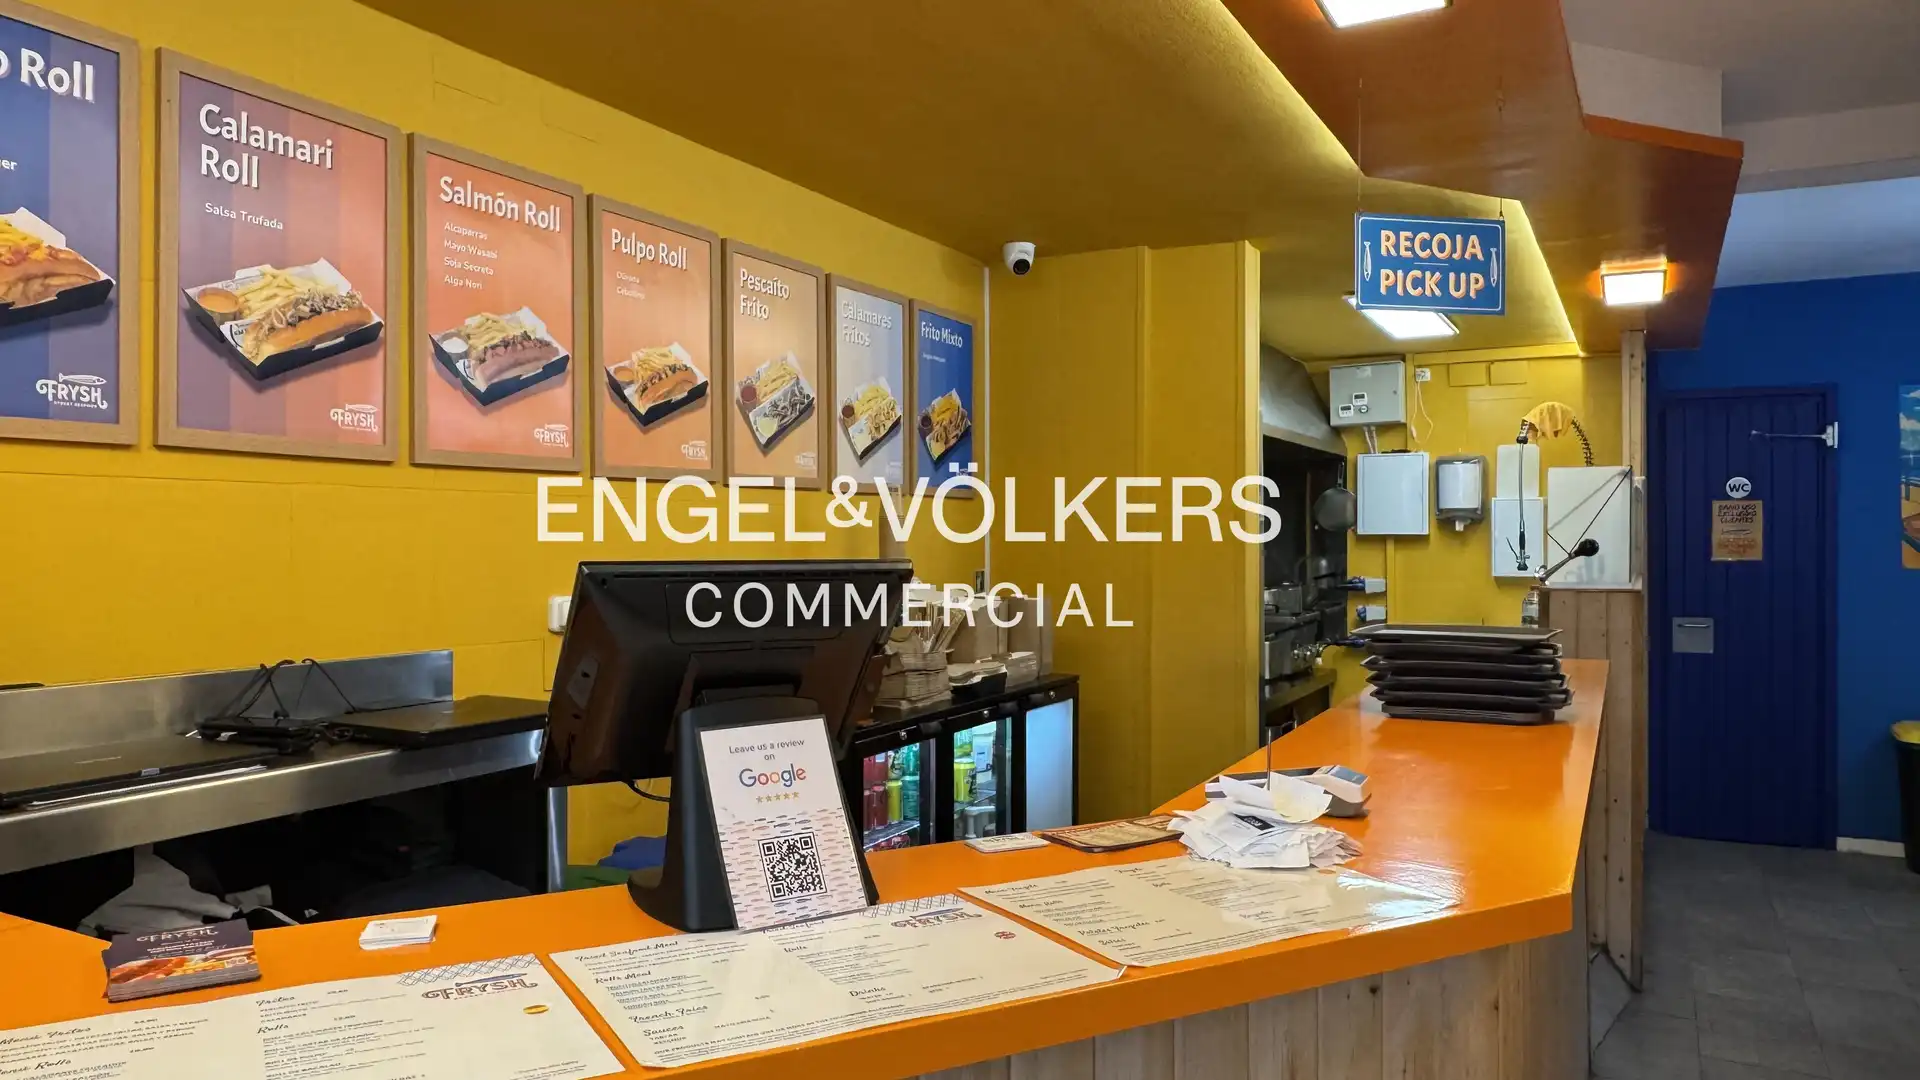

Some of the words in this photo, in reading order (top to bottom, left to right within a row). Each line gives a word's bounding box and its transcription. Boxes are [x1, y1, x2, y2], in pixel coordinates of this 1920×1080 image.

[21, 47, 95, 103] Roll
[199, 103, 333, 170] Calamari
[201, 143, 260, 189] Roll
[204, 202, 233, 219] Salsa
[239, 210, 284, 230] Trufada
[440, 175, 520, 222] Salmón
[524, 199, 561, 233] Roll
[444, 222, 488, 241] Alcaparras
[444, 239, 466, 252] Mayo
[467, 245, 498, 259] Wasabi
[611, 228, 656, 265] Pulpo
[659, 242, 688, 271] Roll
[1380, 229, 1485, 261] RECOJA
[444, 256, 462, 269] Soja
[463, 261, 494, 276] Secreta
[444, 274, 464, 287] Alga
[1380, 268, 1442, 298] PICK
[1449, 271, 1485, 300] UP
[740, 294, 770, 320] Frito
[842, 300, 892, 330] Calamares
[843, 325, 871, 347] Fritos
[921, 321, 940, 342] Frito
[941, 327, 963, 348] Mixto
[36, 379, 108, 409] FRYSH
[330, 408, 379, 433] FRYSH
[1728, 483, 1750, 493] WC
[729, 744, 755, 754] Leave
[777, 738, 805, 749] review
[764, 753, 775, 761] on
[739, 763, 807, 787] Google
[421, 977, 539, 1001] FRYSH
[643, 1025, 685, 1037] Sauces
